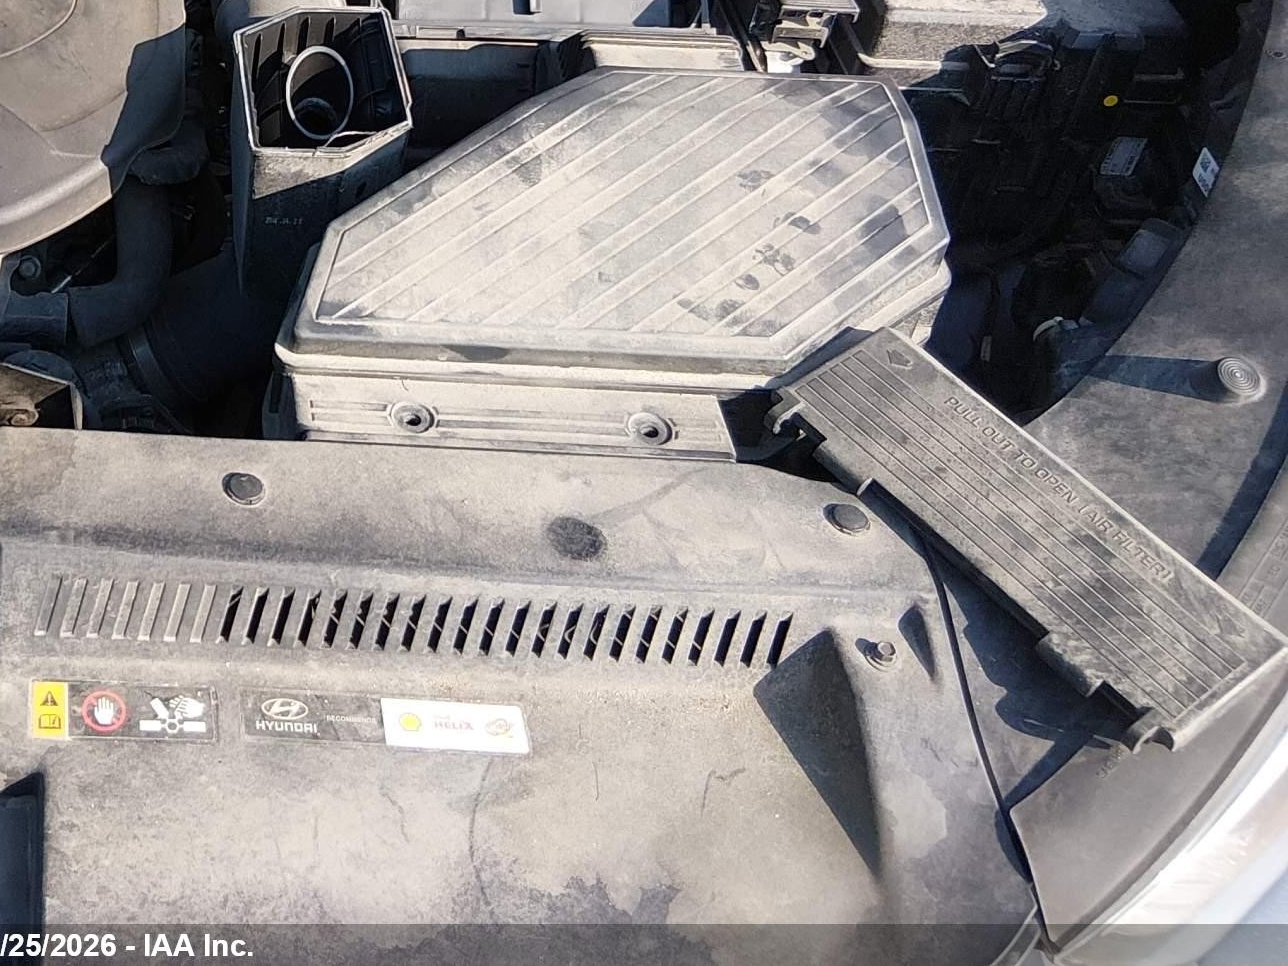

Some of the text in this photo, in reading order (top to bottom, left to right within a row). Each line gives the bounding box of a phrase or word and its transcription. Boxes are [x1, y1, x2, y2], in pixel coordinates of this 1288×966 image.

[944, 396, 984, 429] PULL
[982, 425, 1016, 452] OUT
[1013, 449, 1037, 470] TO
[1034, 468, 1079, 504] OPEN
[1078, 504, 1114, 535] (AIR
[255, 720, 318, 734] HYUNDAI
[434, 720, 474, 731] HELIX
